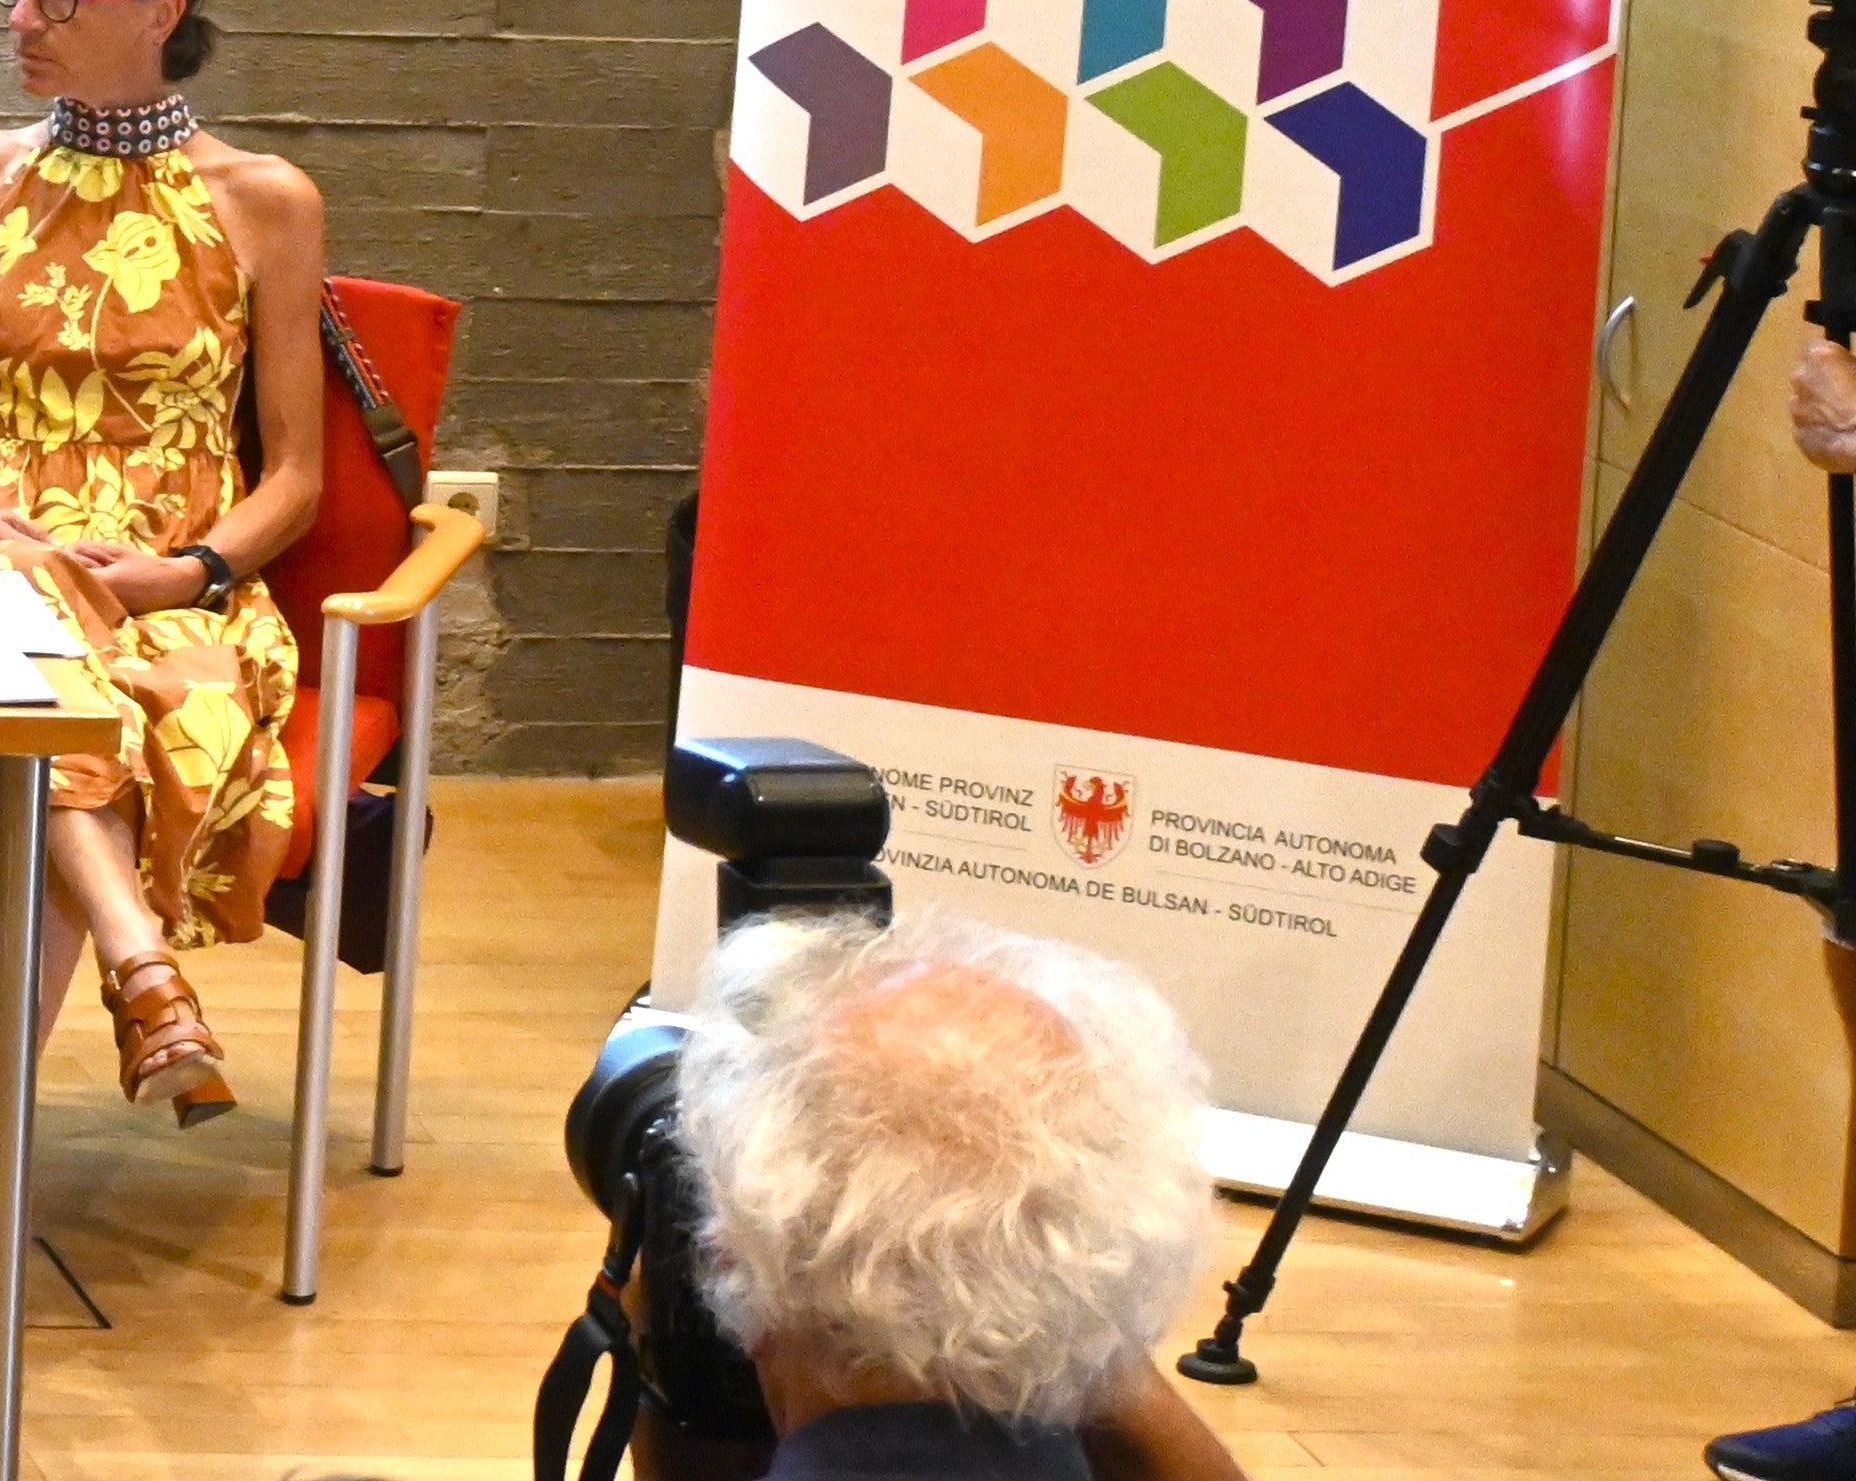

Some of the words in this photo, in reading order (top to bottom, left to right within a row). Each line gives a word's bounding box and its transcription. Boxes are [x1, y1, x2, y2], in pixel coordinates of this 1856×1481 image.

[871, 766, 934, 792] NOME
[939, 777, 1033, 807] PROVINZ
[925, 797, 1032, 833] SÜDTIROL
[1151, 810, 1266, 843] PROVINCIA
[1275, 831, 1397, 865] AUTONOMA
[875, 848, 953, 874] VINZIA
[956, 858, 1079, 896] AUTONOMA
[1086, 879, 1113, 901] DE
[1121, 885, 1209, 916] BULSAN
[1228, 902, 1338, 938] SÜDTIROL
[1149, 836, 1170, 856] DI
[1175, 839, 1275, 871] BOLZANO
[1291, 859, 1345, 883] ALTO
[1350, 868, 1417, 896] ADIGE
